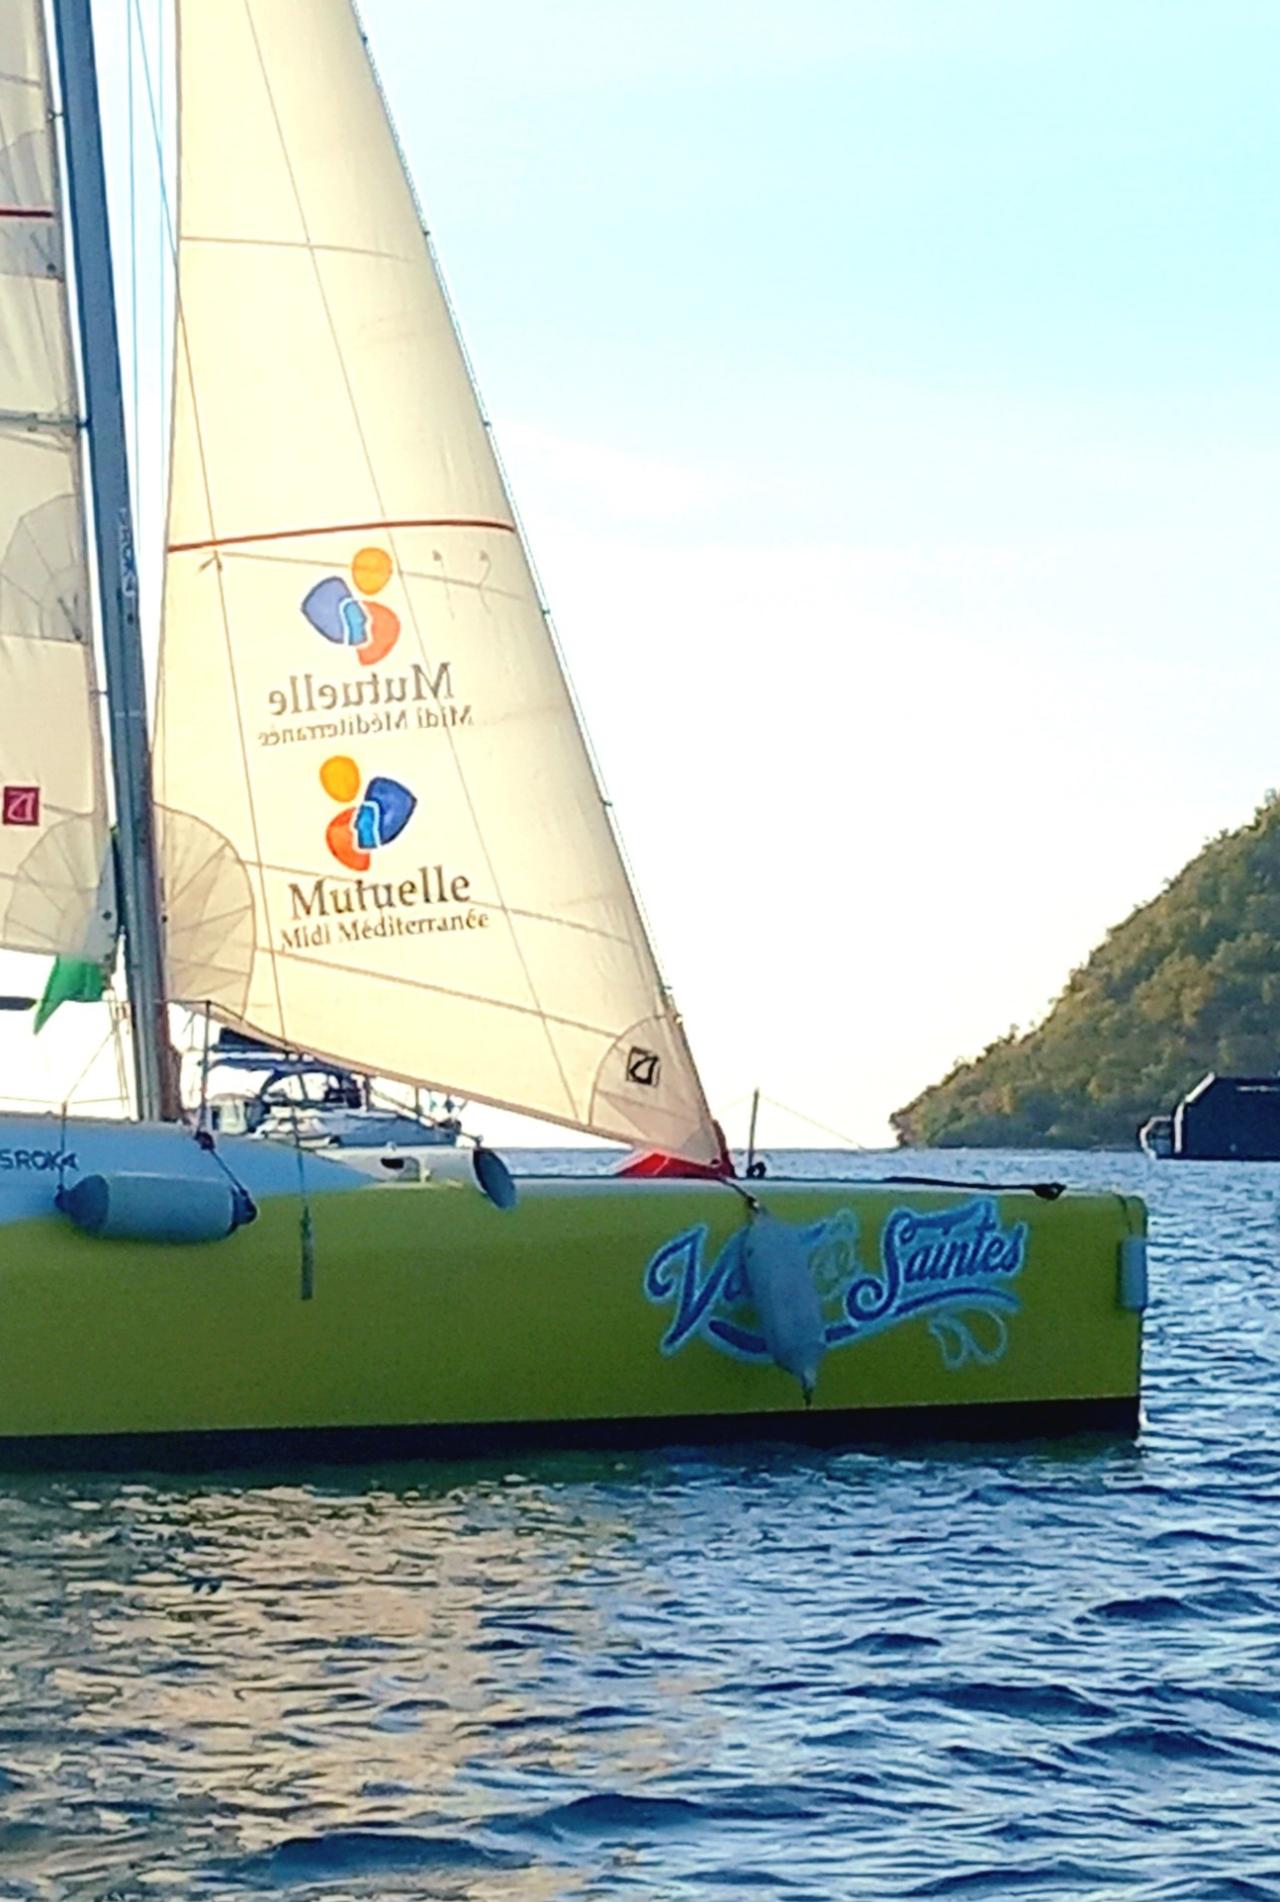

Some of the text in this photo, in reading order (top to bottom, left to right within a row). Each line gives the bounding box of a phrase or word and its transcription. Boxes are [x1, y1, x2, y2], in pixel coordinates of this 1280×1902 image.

[287, 864, 472, 921] Mutuelle
[280, 908, 491, 954] Midi Méditerranée
[845, 1196, 1027, 1323] Saintes
